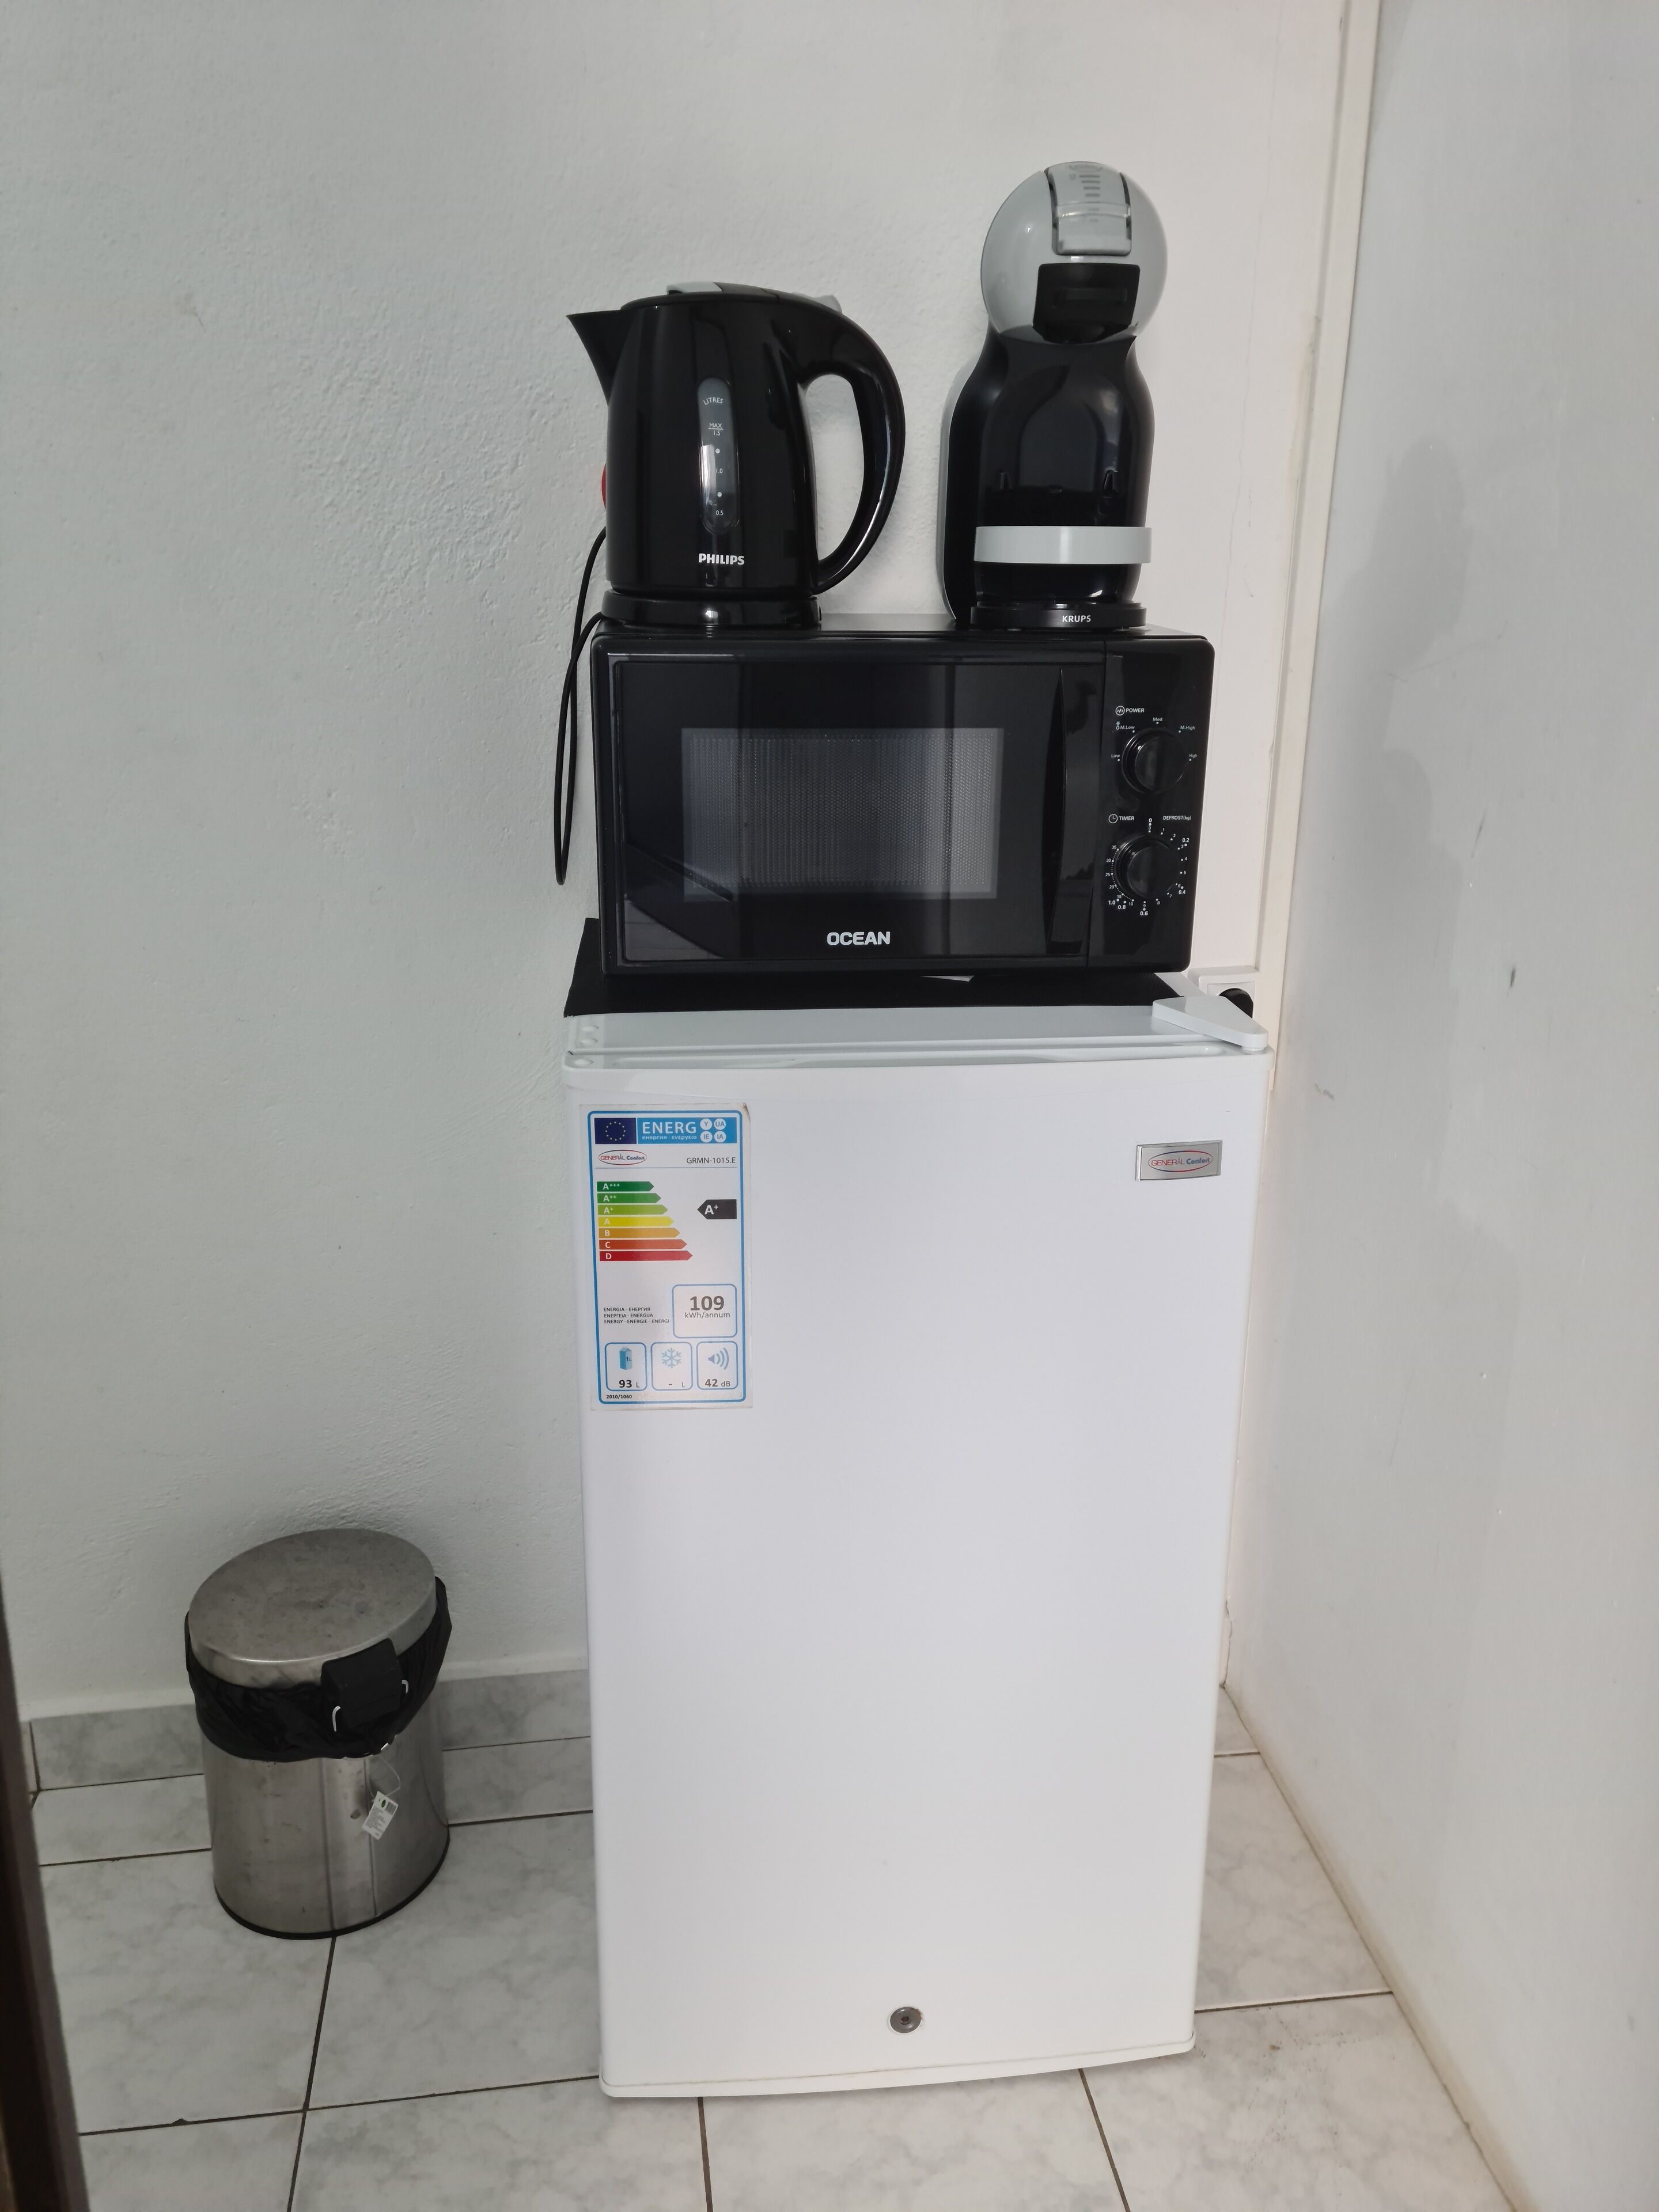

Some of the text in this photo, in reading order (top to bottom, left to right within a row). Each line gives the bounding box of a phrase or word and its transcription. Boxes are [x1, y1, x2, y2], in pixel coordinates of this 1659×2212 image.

[703, 397, 724, 405] LITRES
[698, 553, 745, 565] PHILIPS
[827, 931, 891, 945] OCEAN
[642, 1122, 696, 1134] ENERG
[1152, 1157, 1184, 1166] GENERAL
[704, 1205, 719, 1214] A+
[690, 1296, 724, 1310] 109
[619, 1380, 632, 1388] 93
[704, 1378, 718, 1387] 42
